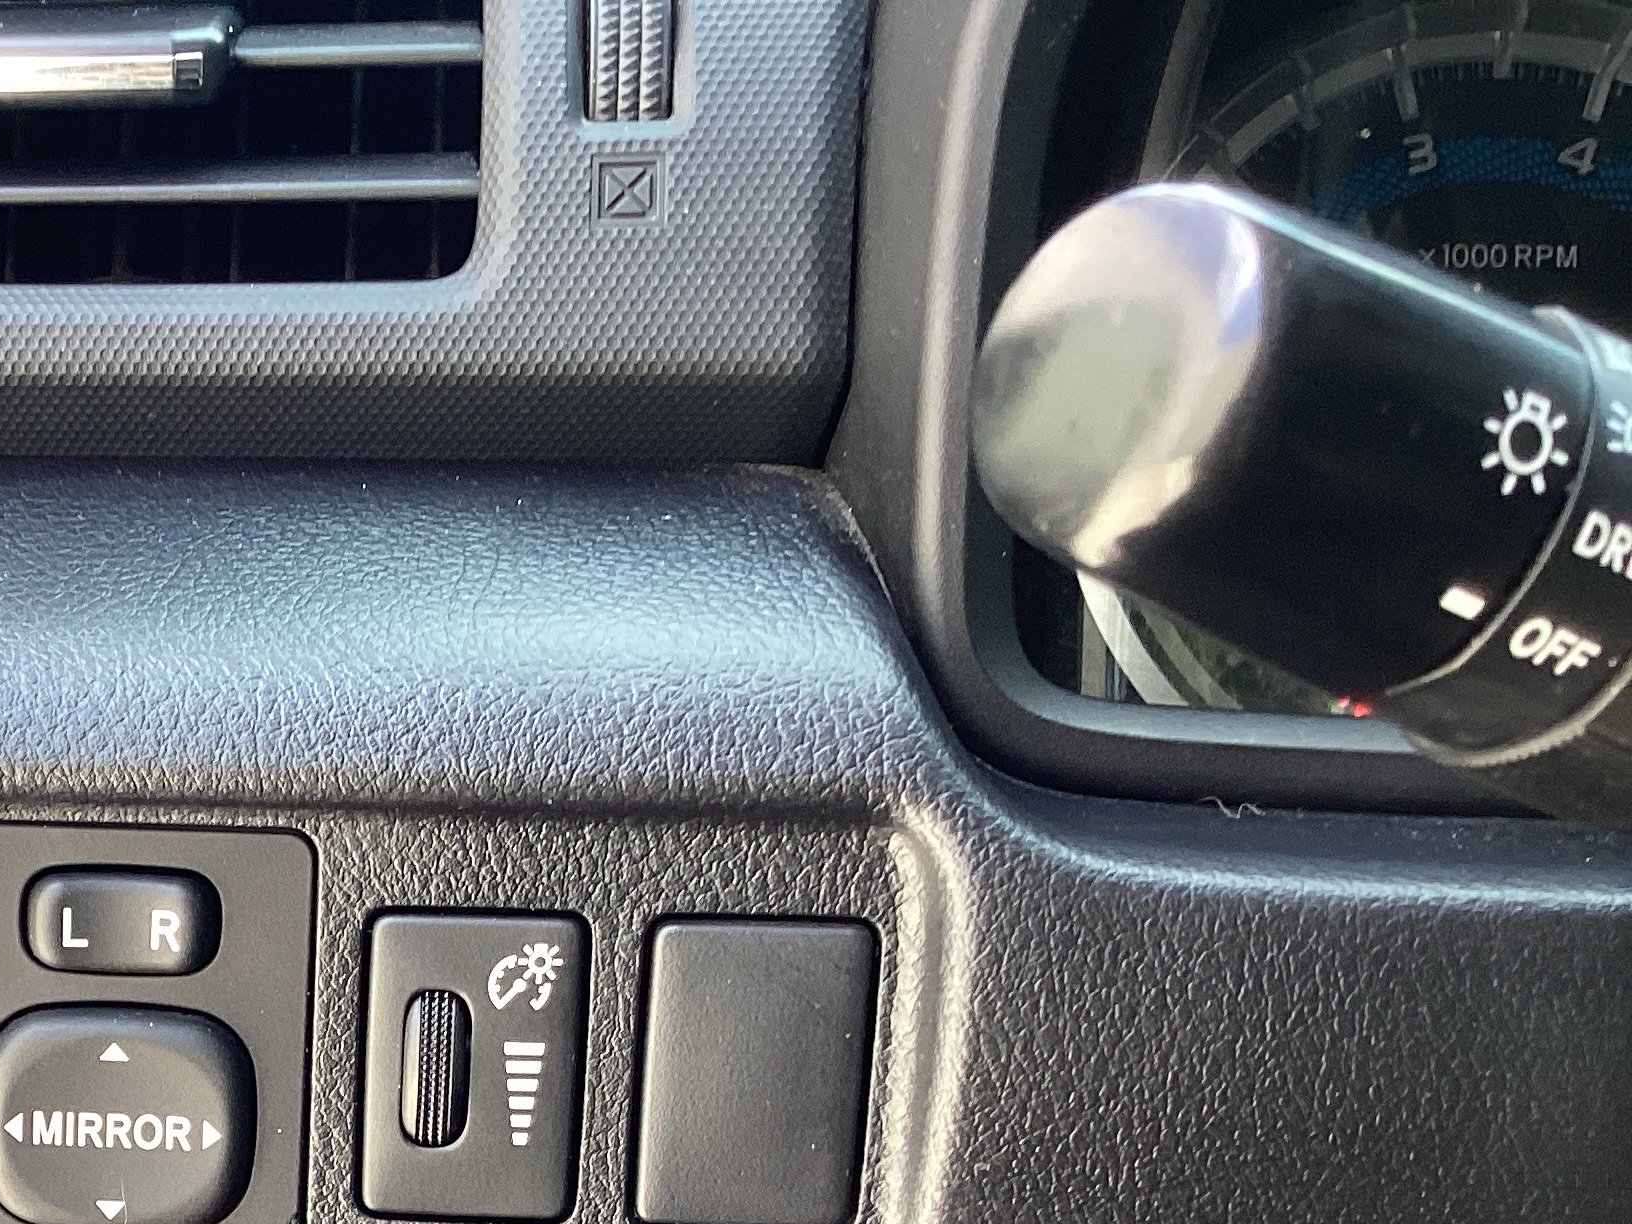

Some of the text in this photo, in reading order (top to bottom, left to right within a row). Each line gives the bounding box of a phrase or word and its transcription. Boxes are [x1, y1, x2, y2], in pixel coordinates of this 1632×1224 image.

[1403, 132, 1438, 177] 3
[1557, 136, 1599, 177] 4
[1514, 243, 1579, 270] RPM
[1571, 508, 1632, 583] DR
[1507, 615, 1604, 678] OFF
[61, 906, 182, 954] L R
[31, 1109, 193, 1153] MIRROR
